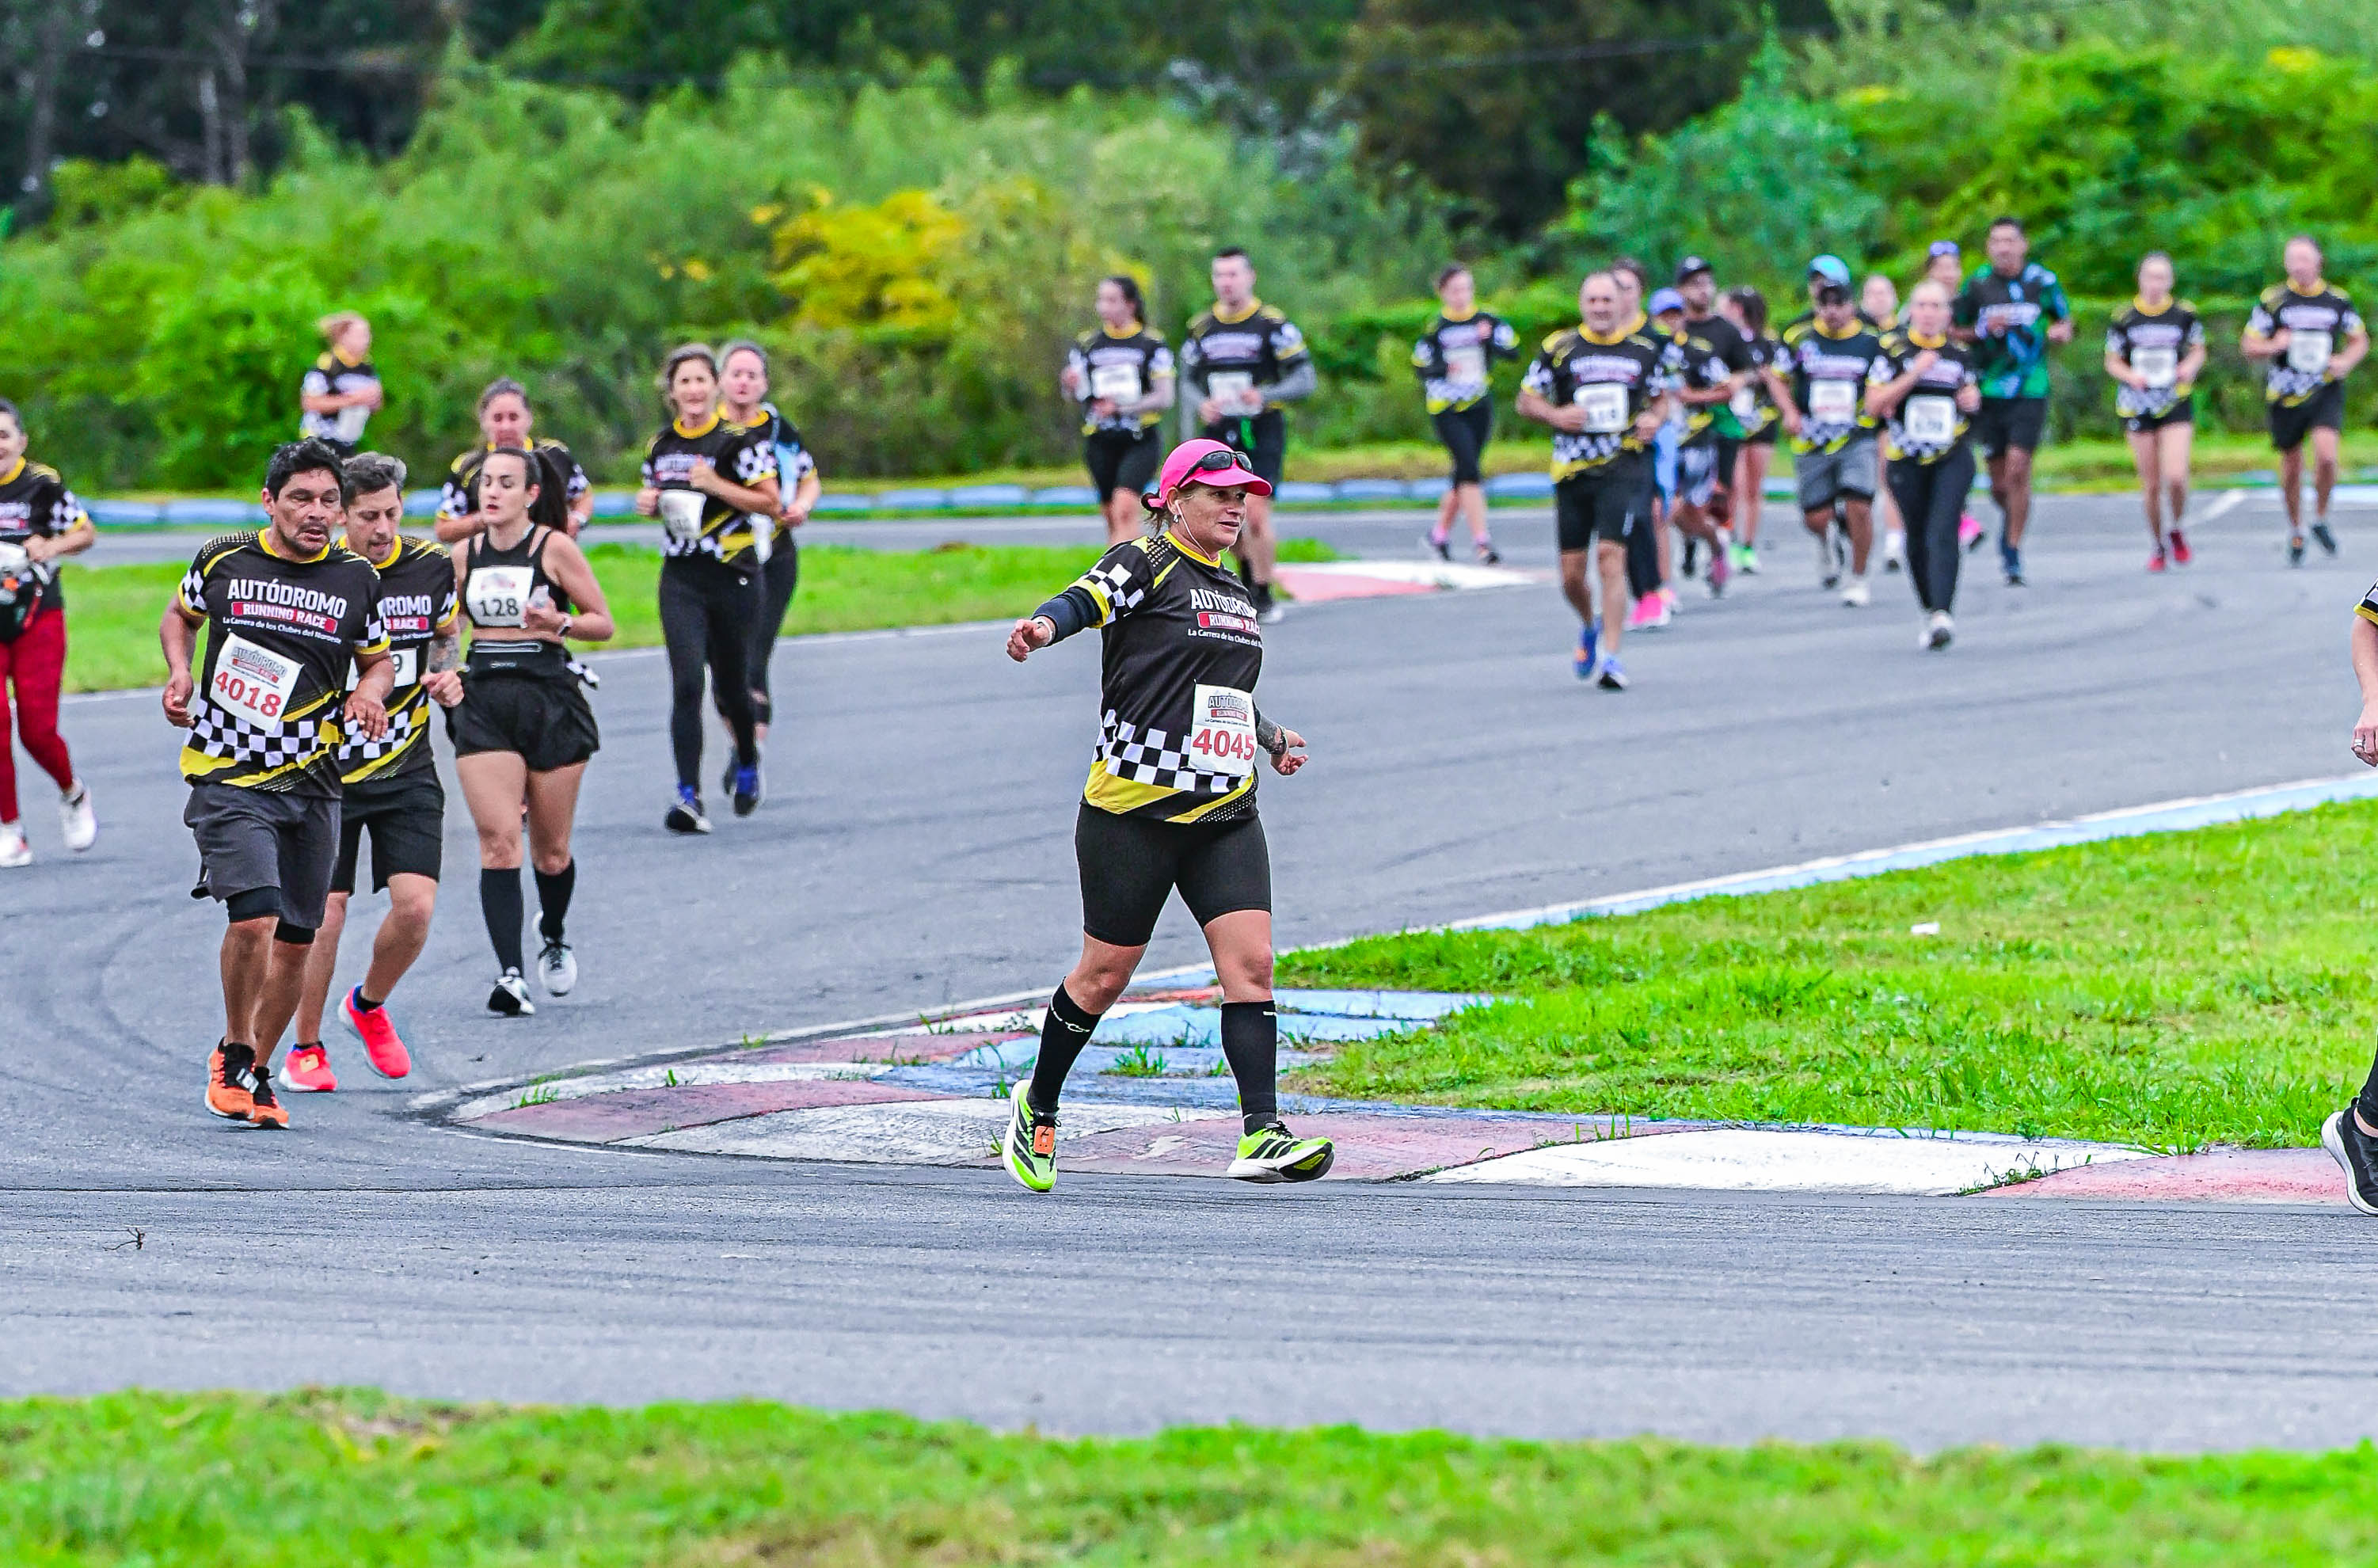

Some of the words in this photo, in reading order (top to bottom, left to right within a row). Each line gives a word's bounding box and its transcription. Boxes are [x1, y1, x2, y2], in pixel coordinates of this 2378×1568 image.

[226, 578, 348, 619] AUTÓDROMO
[385, 595, 432, 616] ROMO
[480, 598, 519, 617] 128
[1189, 588, 1257, 620] AUTÓDROM
[230, 617, 255, 627] Carrera
[266, 622, 276, 630] los
[277, 622, 301, 635] Clubes
[302, 627, 314, 637] del
[242, 603, 295, 622] RUNNING
[295, 611, 327, 630] RACE
[393, 618, 419, 630] RACE
[1208, 614, 1244, 630] RUNNING
[1198, 629, 1220, 638] Carrera
[1235, 635, 1250, 645] Clubes
[215, 671, 281, 717] 4018
[1193, 729, 1255, 761] 4045
